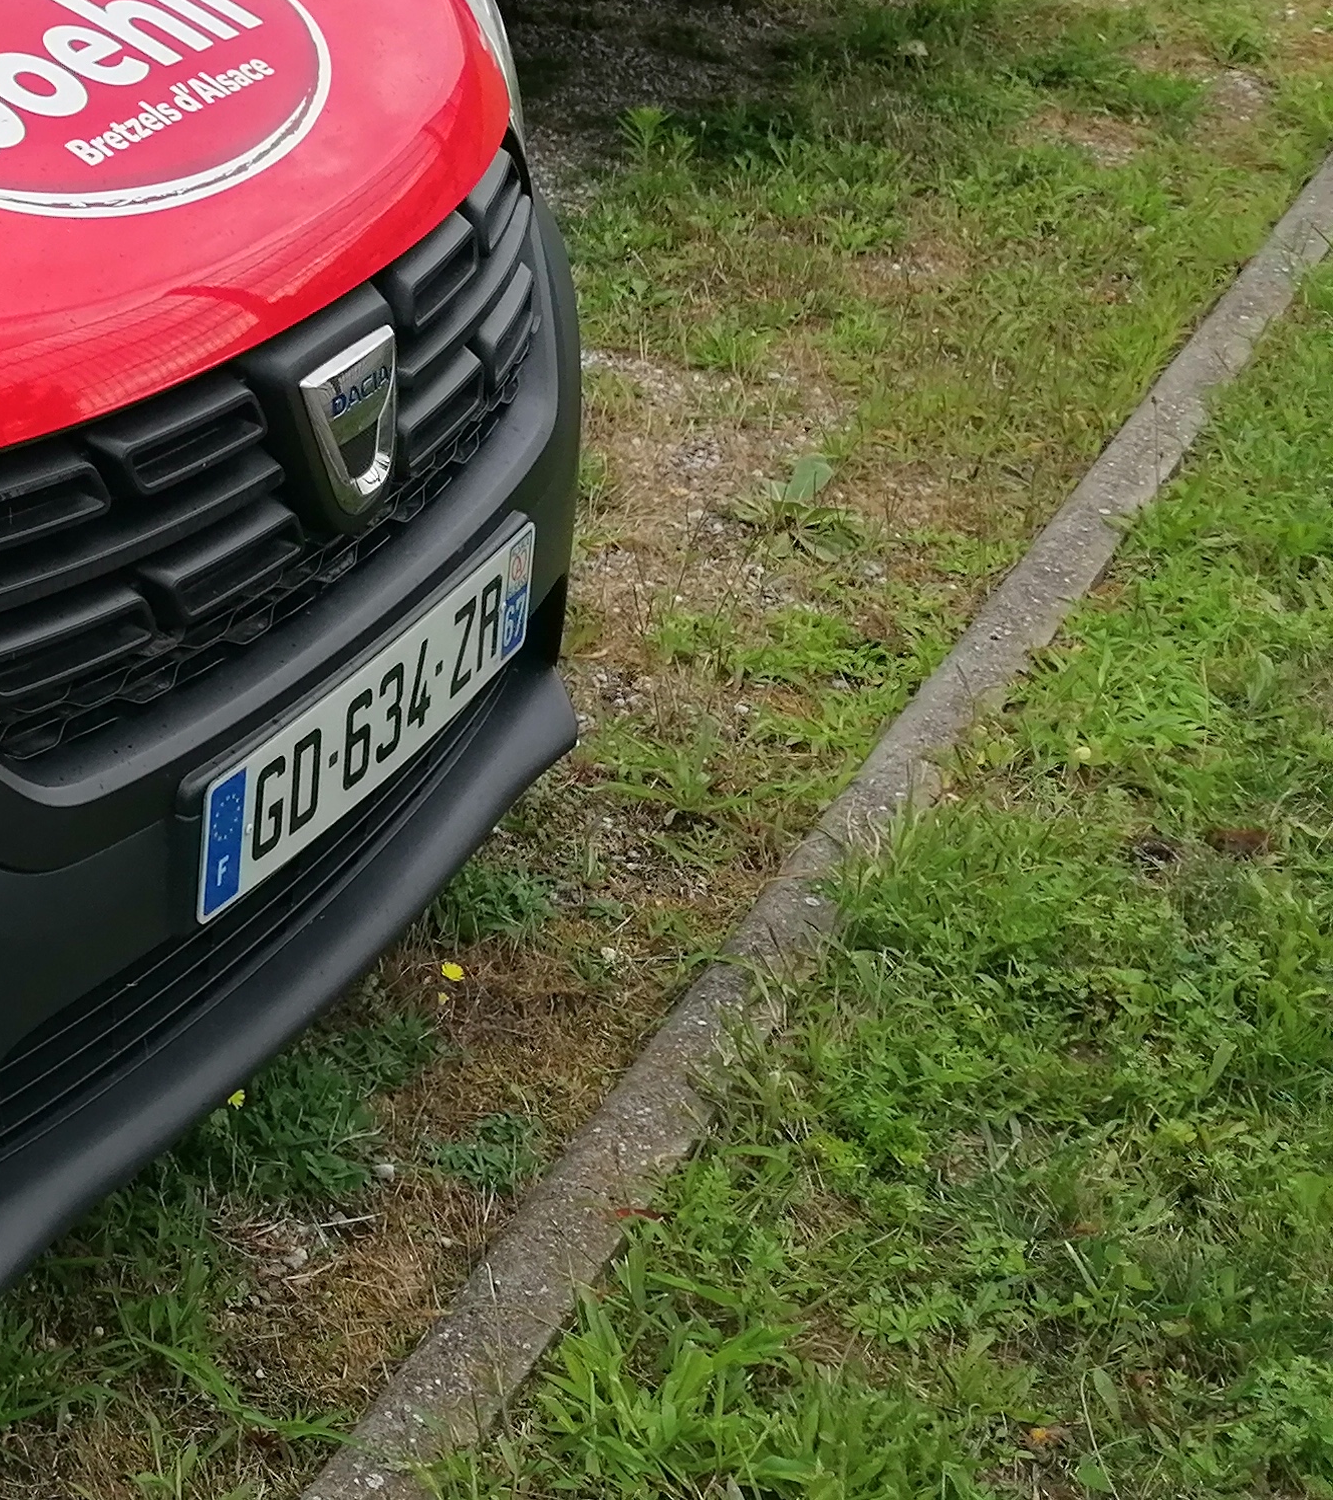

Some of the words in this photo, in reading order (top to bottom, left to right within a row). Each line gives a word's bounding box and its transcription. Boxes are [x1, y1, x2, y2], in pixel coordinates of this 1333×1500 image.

[64, 103, 182, 167] Bretzels
[171, 54, 275, 113] d'Alsace
[331, 366, 389, 417] DACIA
[502, 592, 526, 648] 67
[215, 854, 230, 887] F
